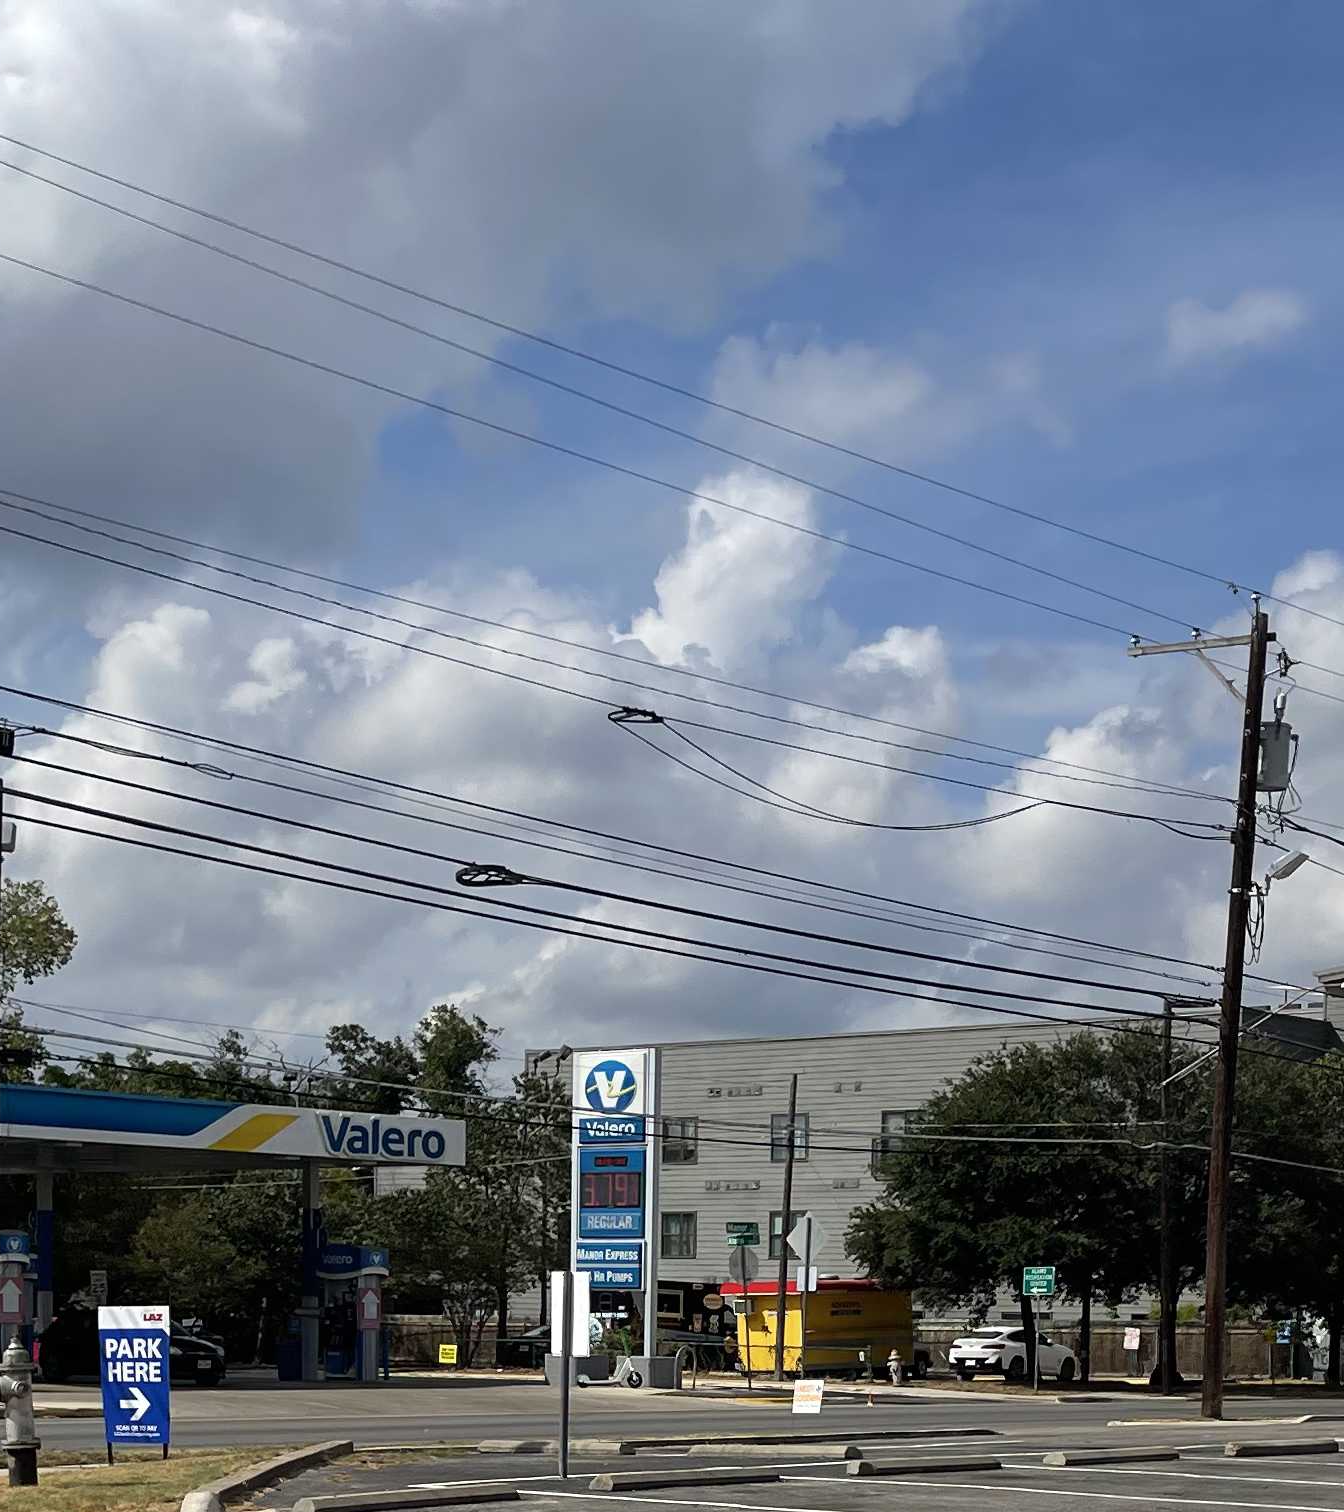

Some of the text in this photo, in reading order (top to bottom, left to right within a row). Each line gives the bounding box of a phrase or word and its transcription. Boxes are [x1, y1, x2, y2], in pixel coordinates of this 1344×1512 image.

[321, 1115, 446, 1159] Valero
[586, 1121, 636, 1137] Valero
[587, 1215, 633, 1230] REGULAR
[143, 1314, 163, 1322] LAZ
[105, 1338, 162, 1359] PARK
[107, 1361, 162, 1382] HERE
